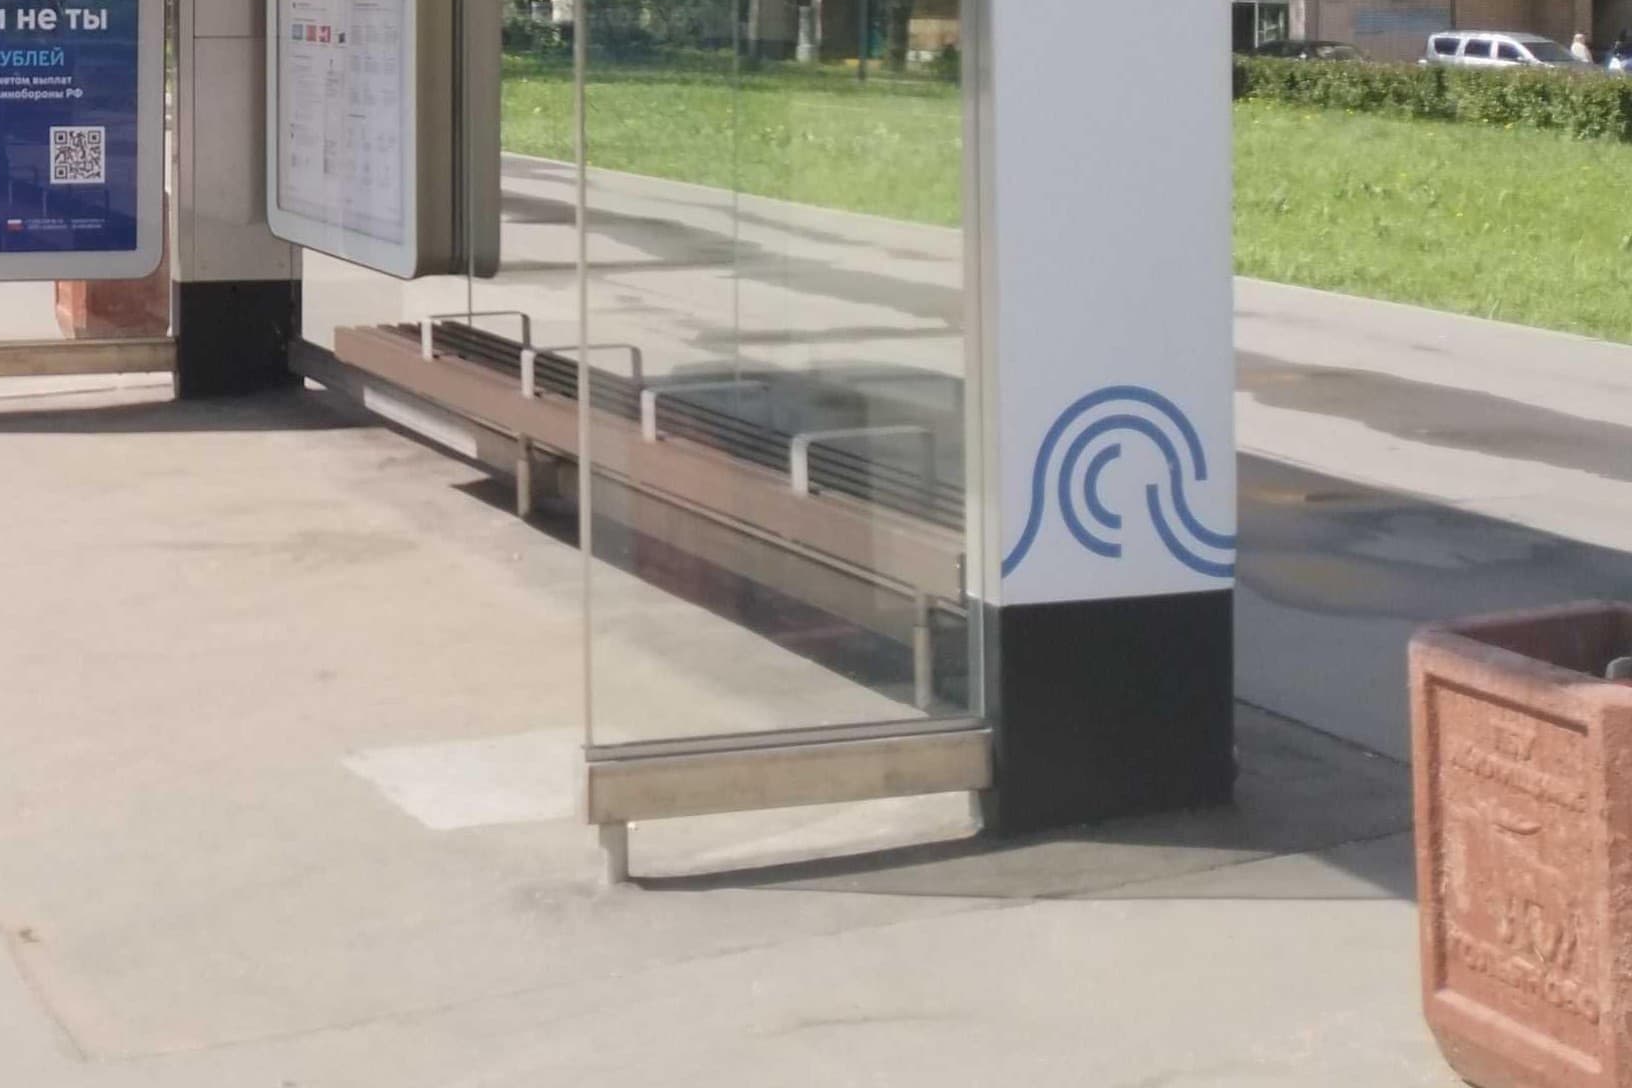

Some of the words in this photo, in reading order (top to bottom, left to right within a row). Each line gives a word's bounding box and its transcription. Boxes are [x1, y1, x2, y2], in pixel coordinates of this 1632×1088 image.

[17, 8, 57, 31] не
[65, 9, 107, 31] ты
[32, 76, 72, 85] выплат
[65, 88, 83, 99] РФ
